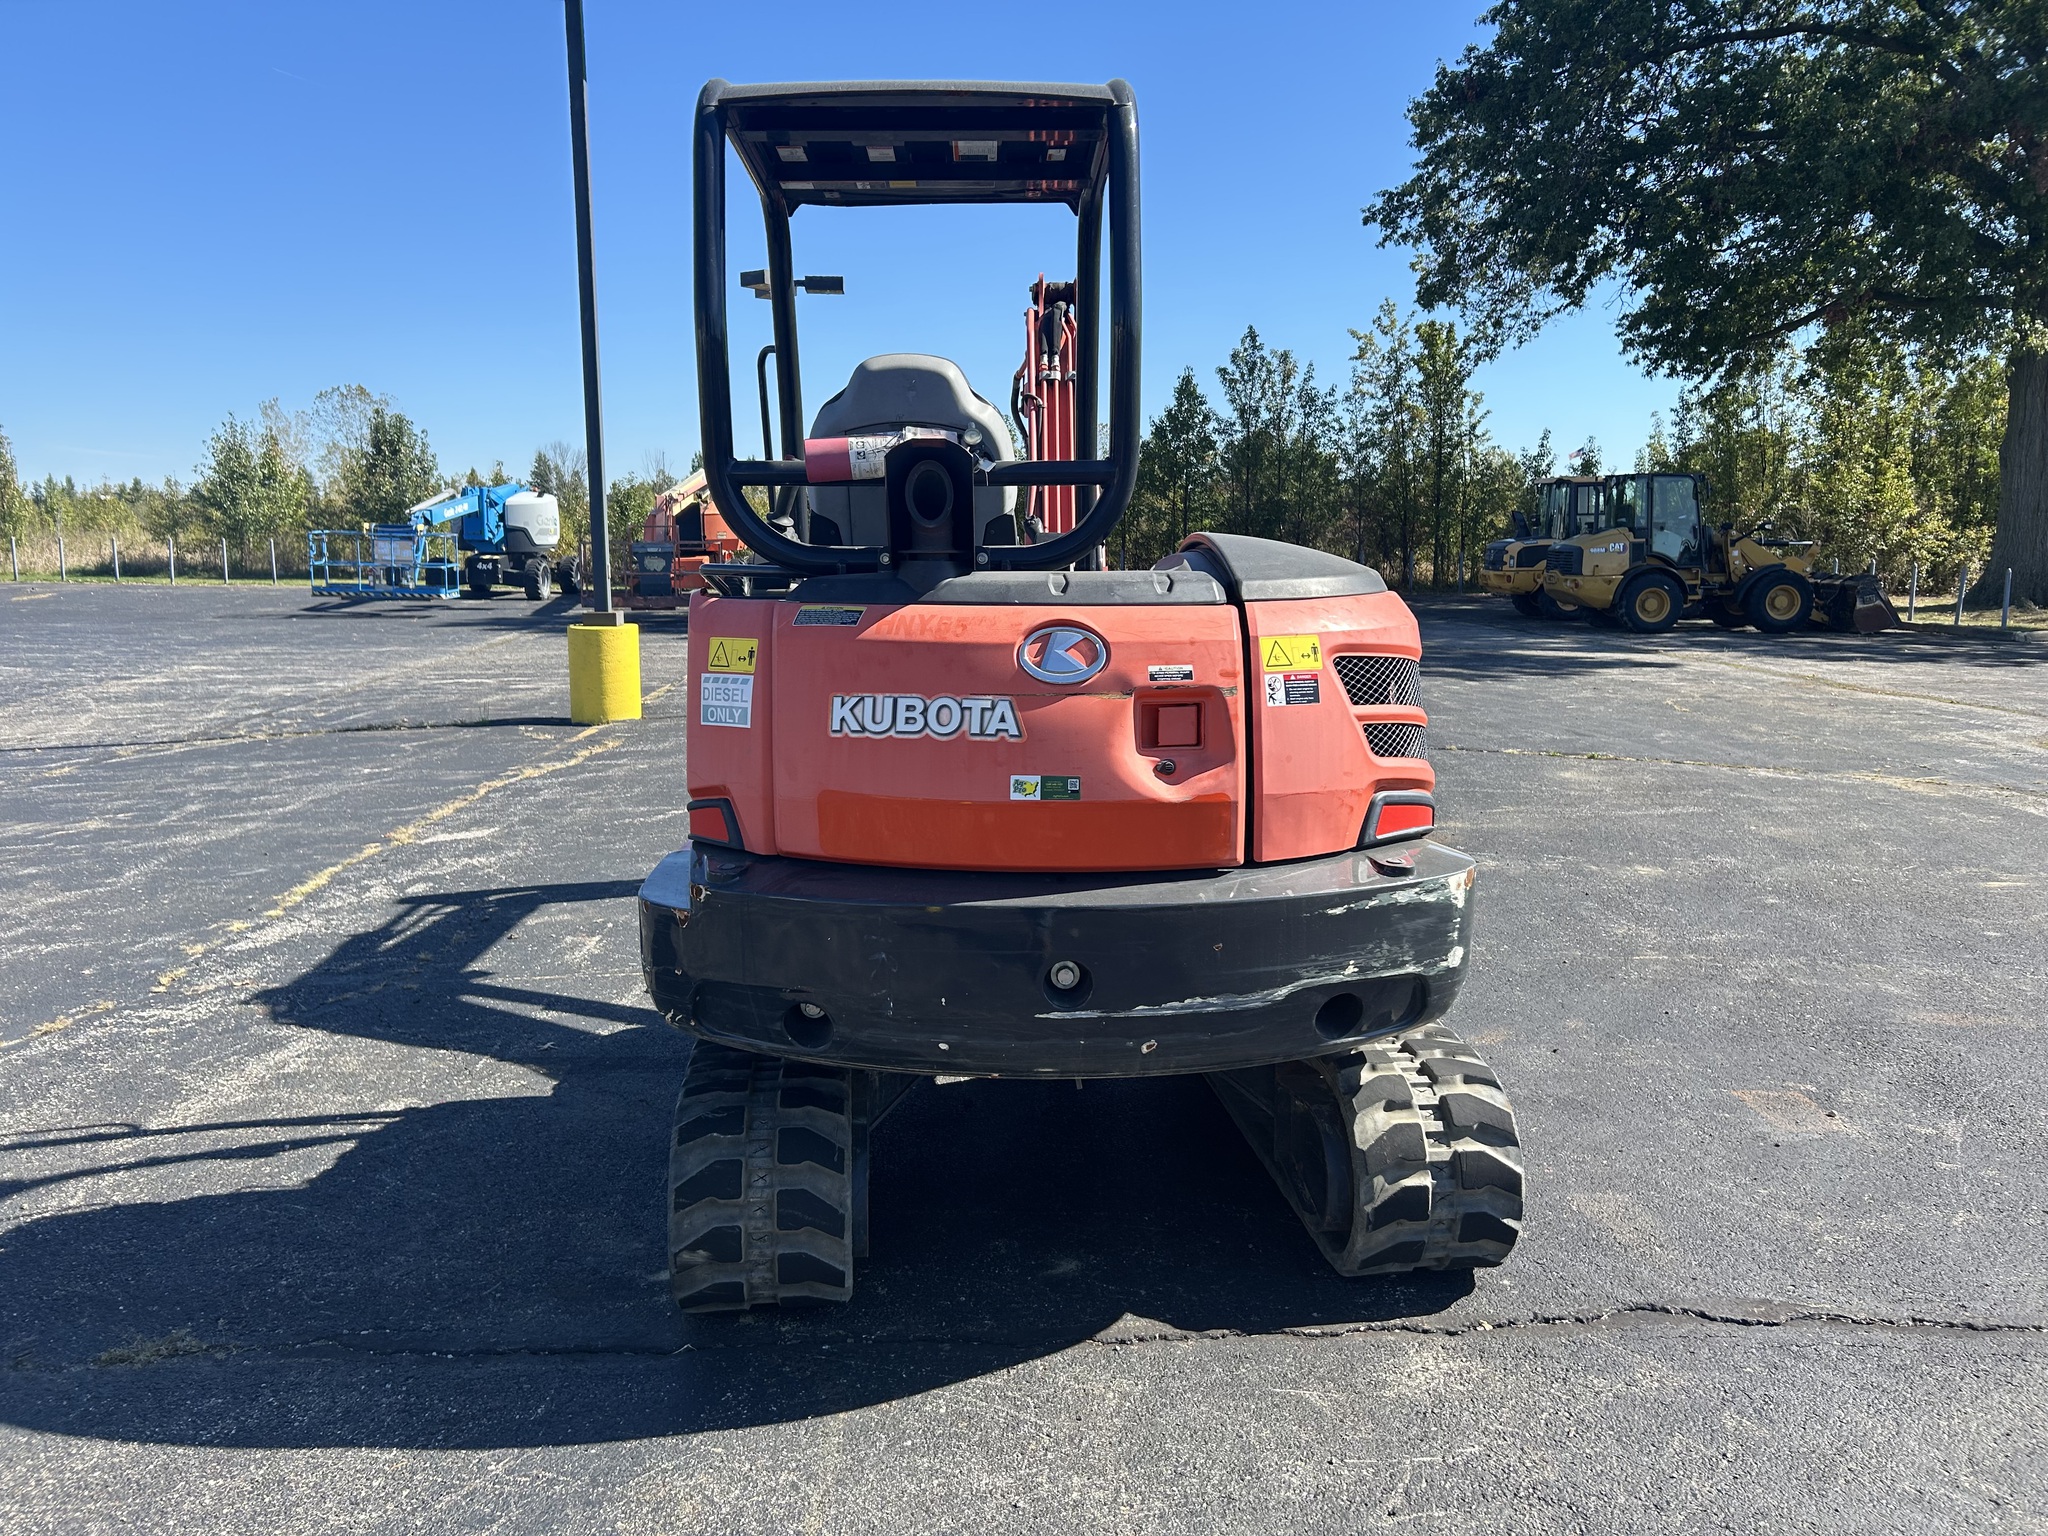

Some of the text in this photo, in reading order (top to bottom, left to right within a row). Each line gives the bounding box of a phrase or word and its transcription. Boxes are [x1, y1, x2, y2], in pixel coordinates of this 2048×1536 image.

[1609, 542, 1625, 552] CAT
[476, 561, 493, 570] 4x4
[702, 687, 749, 703] DIESEL
[707, 706, 743, 724] ONLY
[831, 695, 1021, 738] KUBOTA
